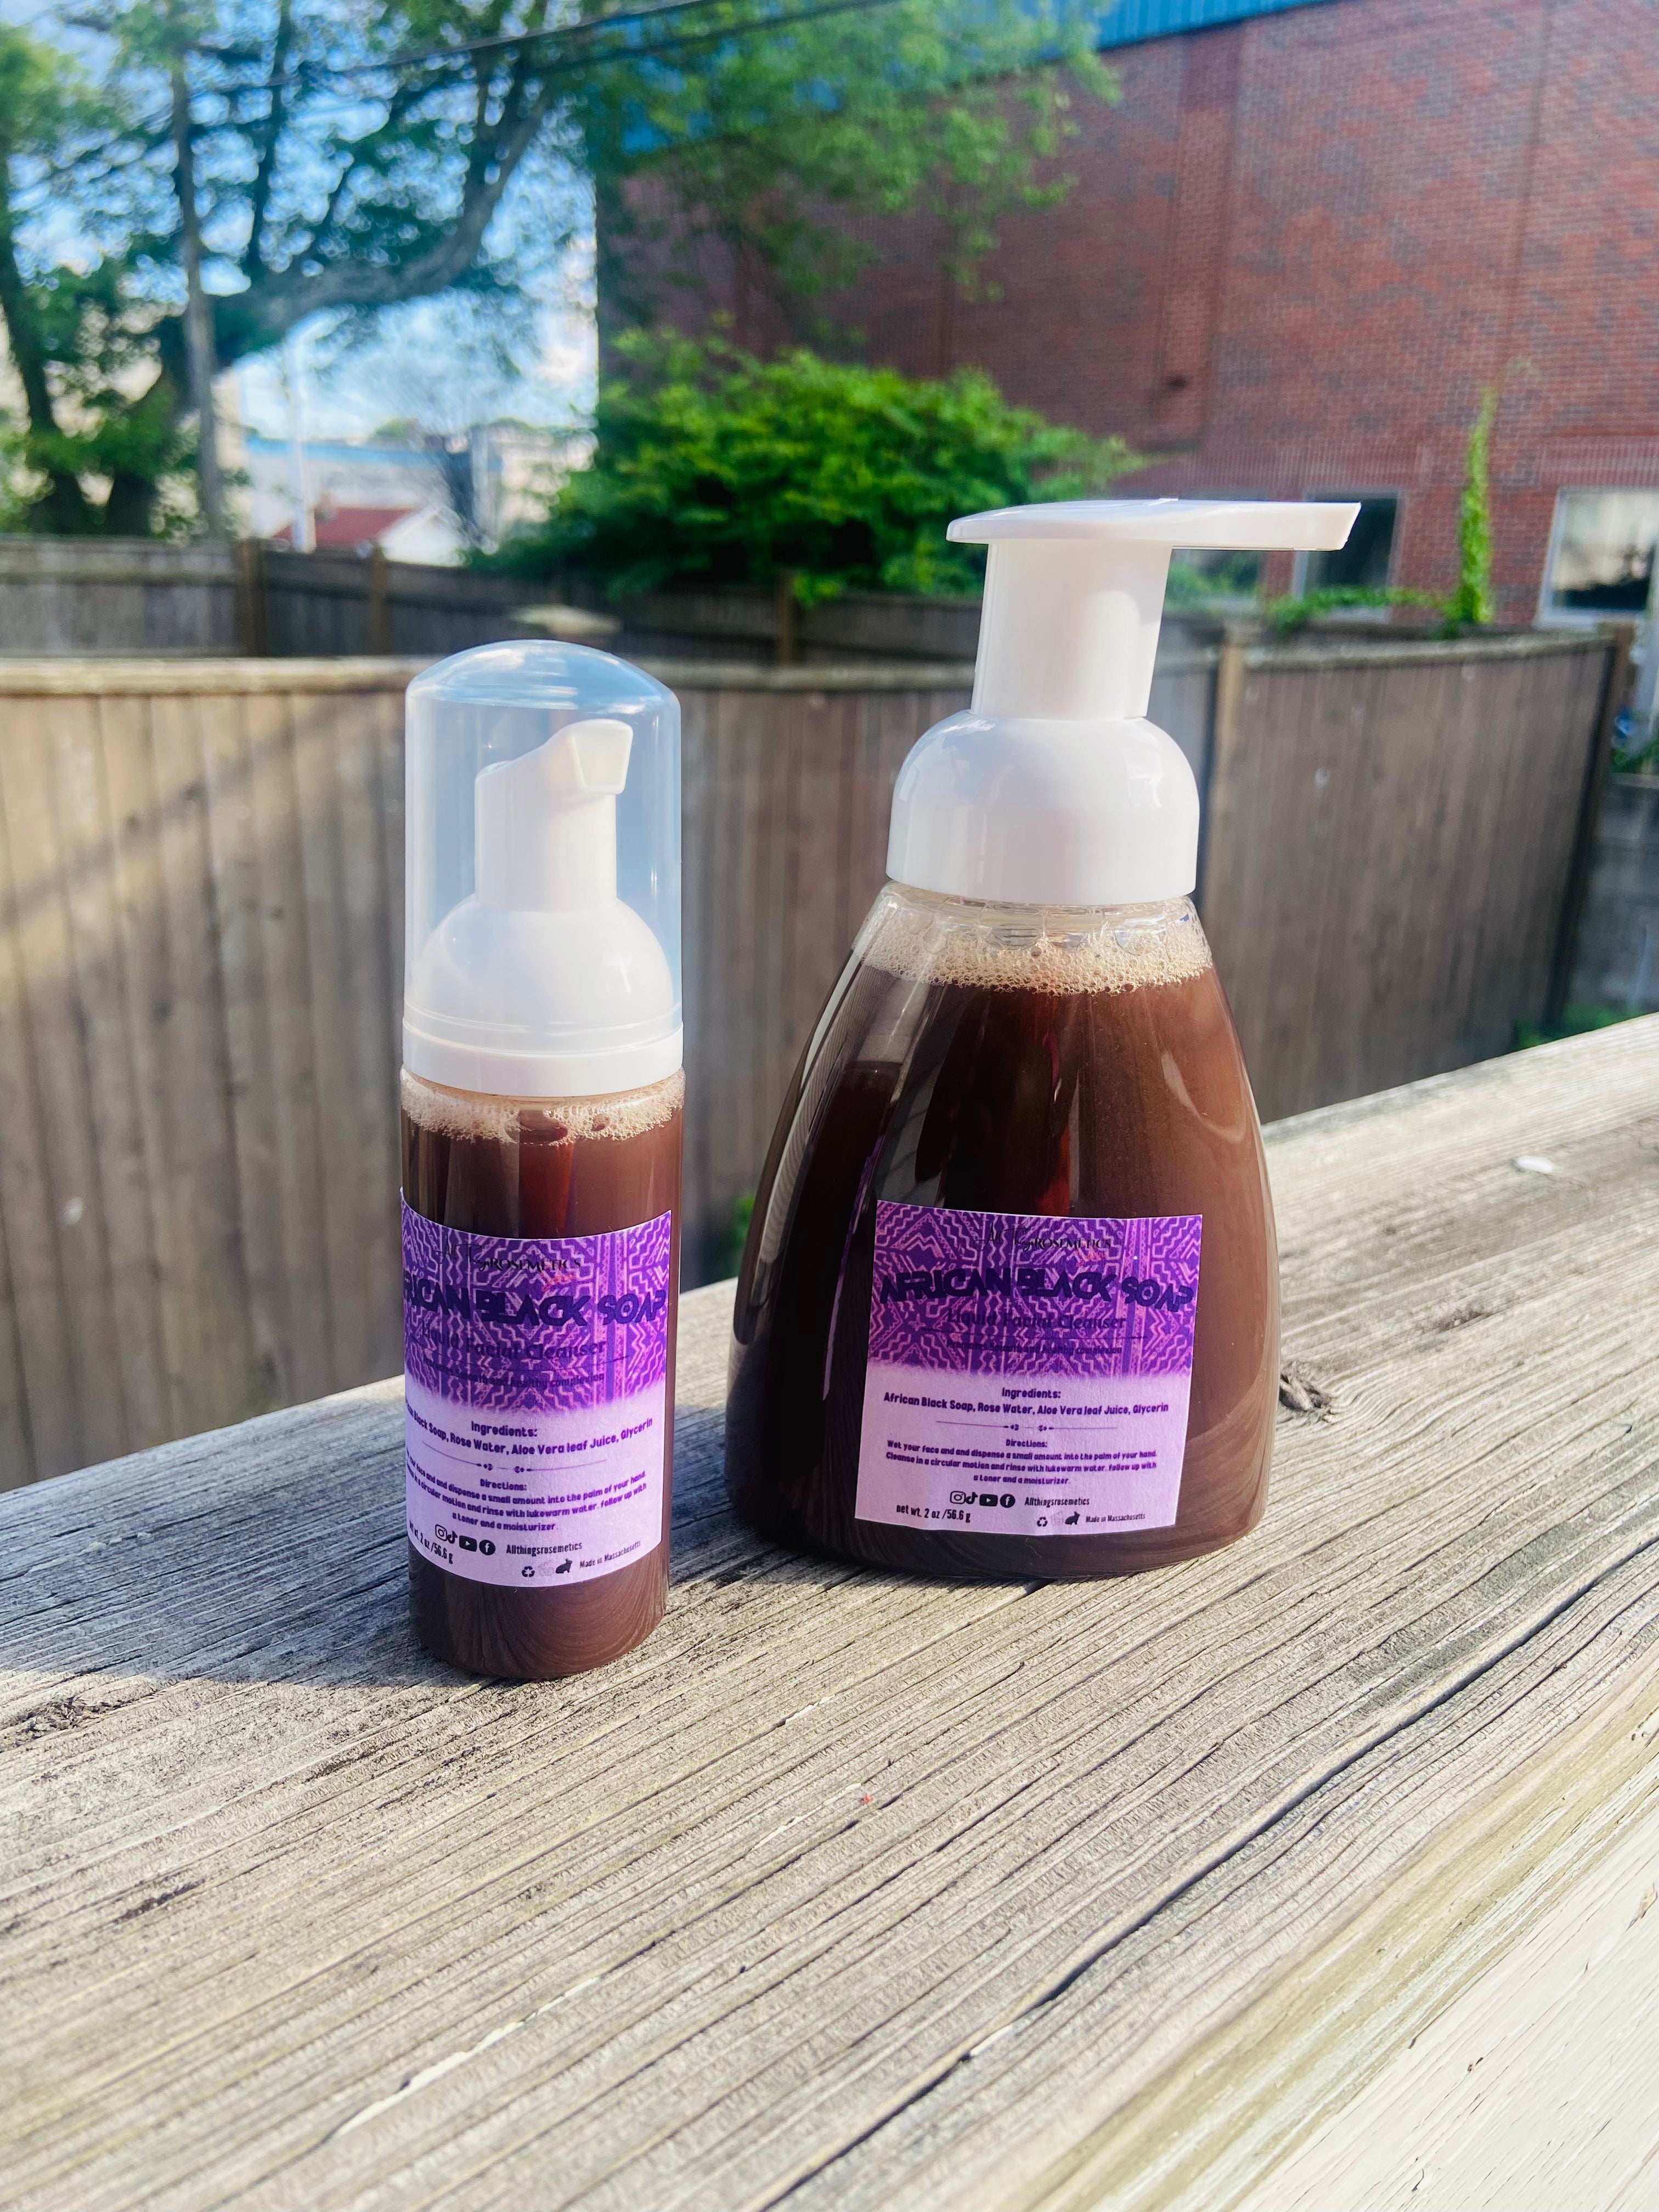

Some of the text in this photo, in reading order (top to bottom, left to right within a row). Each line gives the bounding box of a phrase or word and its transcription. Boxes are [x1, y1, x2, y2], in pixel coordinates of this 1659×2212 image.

[879, 1268, 1194, 1312] AFRICAN BLACK SOAP
[476, 1290, 591, 1327] BLACK
[597, 1289, 666, 1326] SOAP
[947, 1308, 1126, 1329] Liquid Facial Cleanser
[527, 1341, 606, 1357] Cleanser
[1002, 1387, 1061, 1399] Ingredients:
[884, 1392, 1169, 1415] African Black Soap, Rose Water, Aloe Vera leaf Juice, Glycerin
[429, 1422, 449, 1442] Soap,
[450, 1432, 471, 1448] Rose
[473, 1438, 509, 1455] Water,
[511, 1444, 535, 1454] Aloe
[538, 1444, 565, 1455] Vera
[566, 1440, 588, 1453] leaf
[590, 1434, 619, 1449] Juice,
[620, 1417, 653, 1440] Glycerin
[471, 1420, 538, 1437] Ingredients:
[887, 1440, 901, 1449] Wet
[903, 1443, 921, 1452] your
[922, 1445, 939, 1454] face
[971, 1449, 1005, 1459] dispense
[1094, 1453, 1111, 1461] palm
[1122, 1452, 1138, 1460] your
[1006, 1439, 1048, 1448] Directions:
[886, 1452, 915, 1463] Cleanse
[916, 1455, 923, 1464] in
[930, 1458, 961, 1468] circular
[962, 1461, 990, 1470] motion
[1006, 1463, 1025, 1471] rinse
[1045, 1464, 1081, 1472] lukewarm
[1141, 1462, 1156, 1470] with
[480, 1478, 527, 1491] Directions:
[979, 1474, 1001, 1482] toner
[436, 1479, 448, 1489] and
[448, 1483, 480, 1499] dispense
[488, 1494, 511, 1504] small
[512, 1497, 546, 1505] amount
[548, 1495, 565, 1504] into
[567, 1493, 582, 1502] the
[583, 1489, 603, 1501] palm
[604, 1485, 612, 1494] of
[613, 1480, 629, 1493] your
[442, 1494, 466, 1509] motion
[467, 1504, 481, 1513] and
[482, 1505, 504, 1516] rinse
[506, 1509, 525, 1517] with
[527, 1509, 570, 1518] lukewarm
[601, 1494, 623, 1508] follow
[624, 1491, 632, 1499] up
[633, 1482, 647, 1495] with
[1024, 1497, 1090, 1508] Allthingsrosemetics
[458, 1513, 478, 1525] toner
[481, 1520, 495, 1529] and
[896, 1504, 970, 1523] net wt. 2 oz /56.6 g
[1107, 1513, 1146, 1522] Massachusetts
[506, 1542, 583, 1557] Allthingsrosemetics
[448, 1552, 453, 1565] g
[579, 1559, 595, 1568] Made
